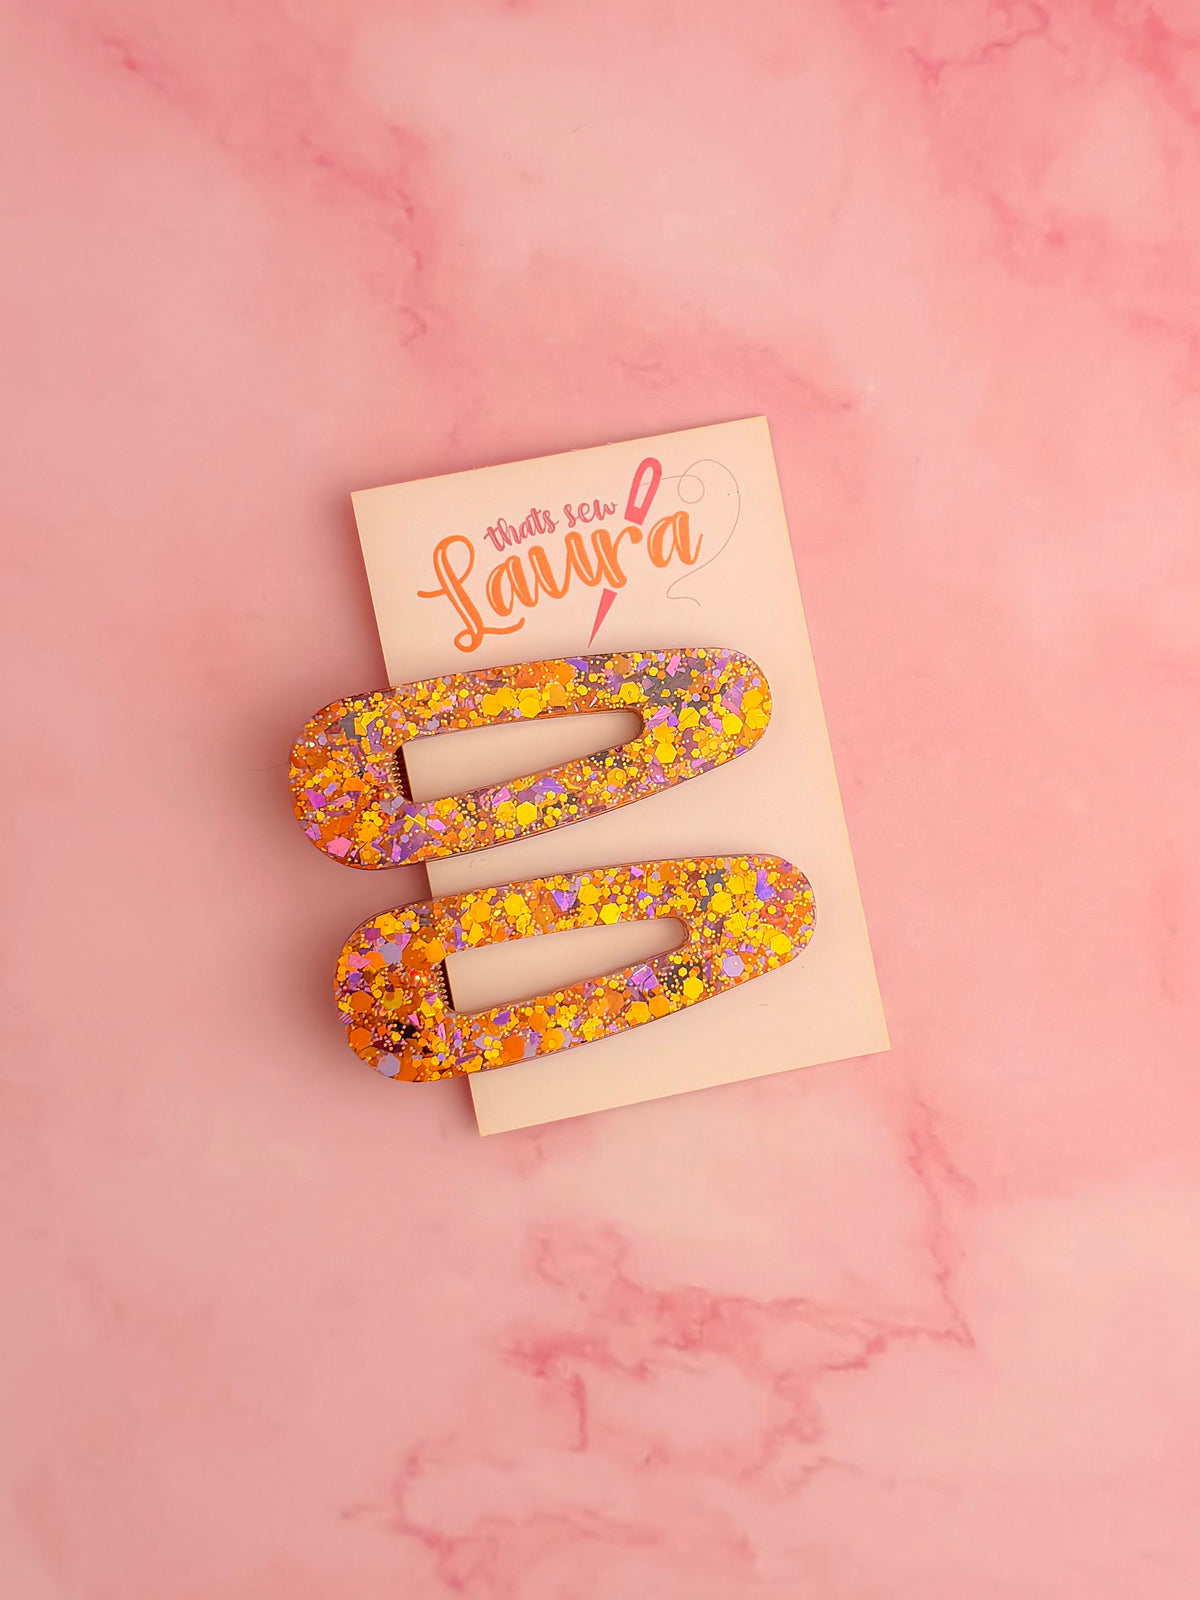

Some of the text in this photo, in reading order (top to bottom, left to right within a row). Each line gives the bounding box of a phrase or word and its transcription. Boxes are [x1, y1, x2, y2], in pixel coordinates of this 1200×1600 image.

[483, 499, 618, 552] thats sew
[416, 510, 704, 653] Laura
